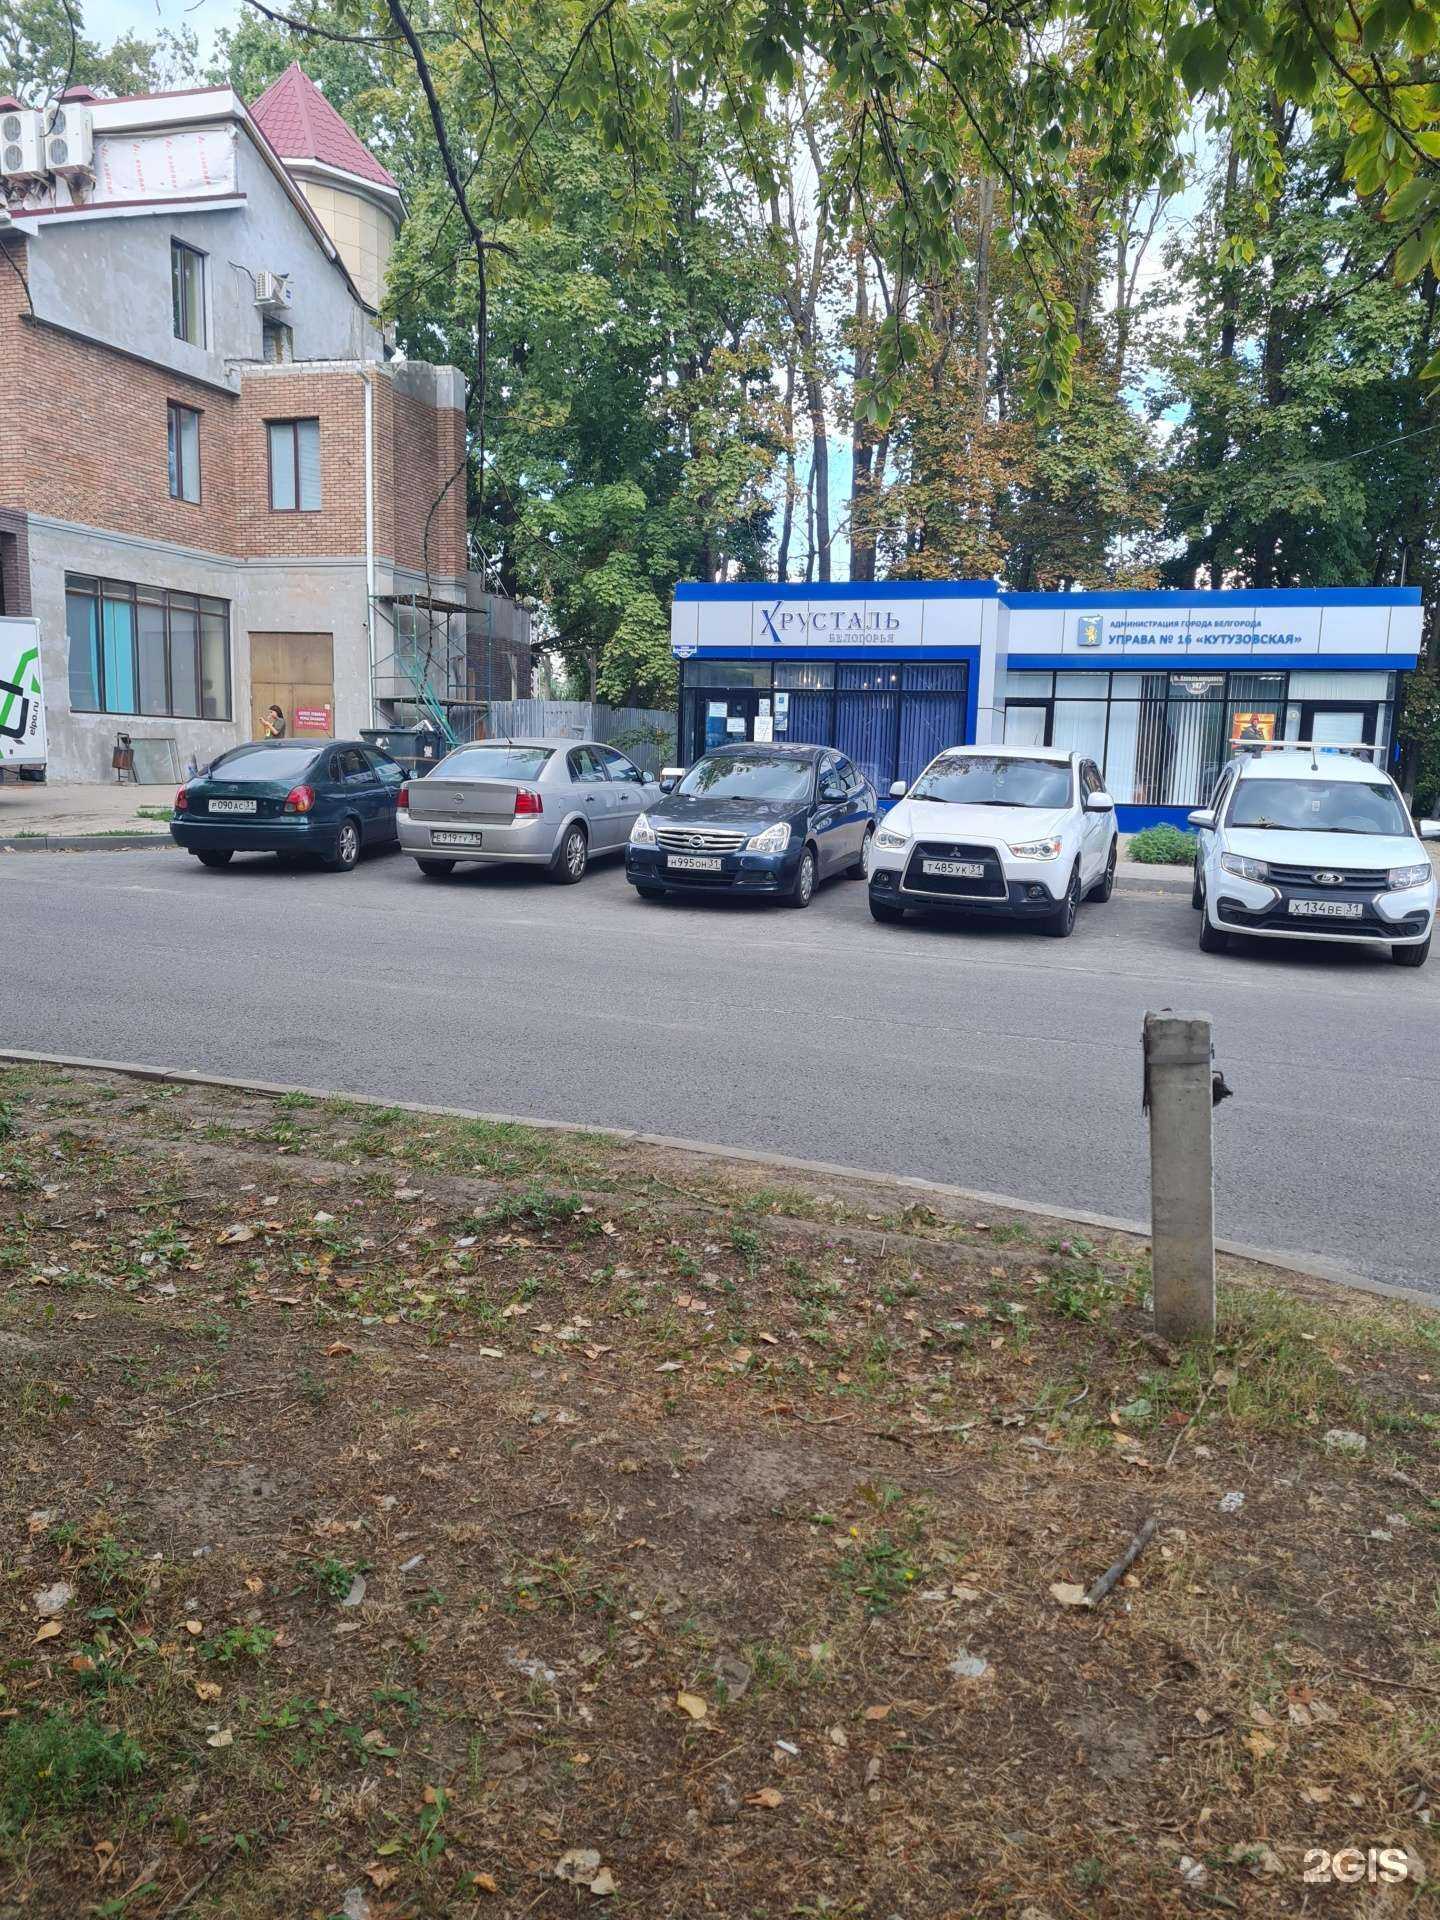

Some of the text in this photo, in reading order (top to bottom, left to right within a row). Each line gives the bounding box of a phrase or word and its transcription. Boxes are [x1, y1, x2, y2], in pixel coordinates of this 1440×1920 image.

[760, 600, 900, 644] ХРУСТАЛЬ
[1110, 619, 1262, 629] АДМИНИСТРАЦИЯ ГОРОДА БЕЛГОРОДА
[828, 633, 895, 644] БЕЛОГОРЬЯ
[1108, 633, 1302, 645] УПРАВА № 16 «КУТУЗОВСКАЯ»
